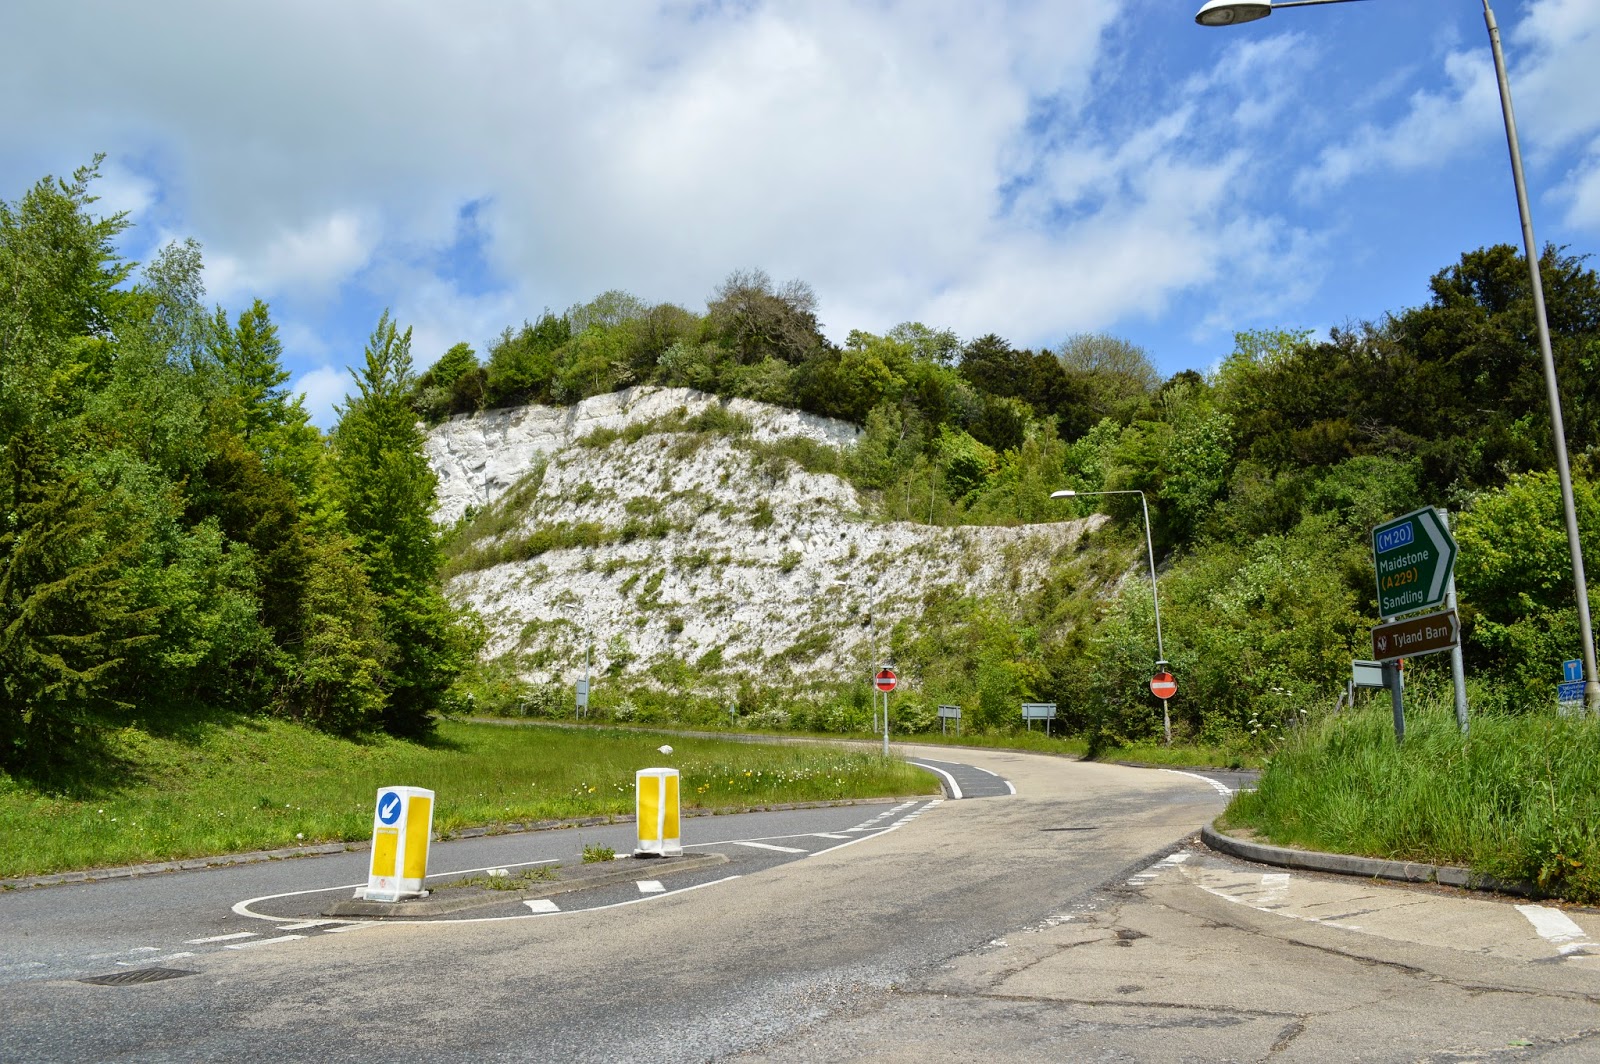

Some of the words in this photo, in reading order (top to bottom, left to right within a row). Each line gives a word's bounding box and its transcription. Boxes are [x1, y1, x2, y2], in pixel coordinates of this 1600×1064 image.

[1379, 525, 1411, 549] (M20)
[1380, 550, 1429, 573] Maidstone
[1381, 567, 1418, 591] (A229)
[1383, 590, 1423, 610] Sandling
[1393, 629, 1423, 648] Tyland
[1425, 626, 1448, 640] Barn
